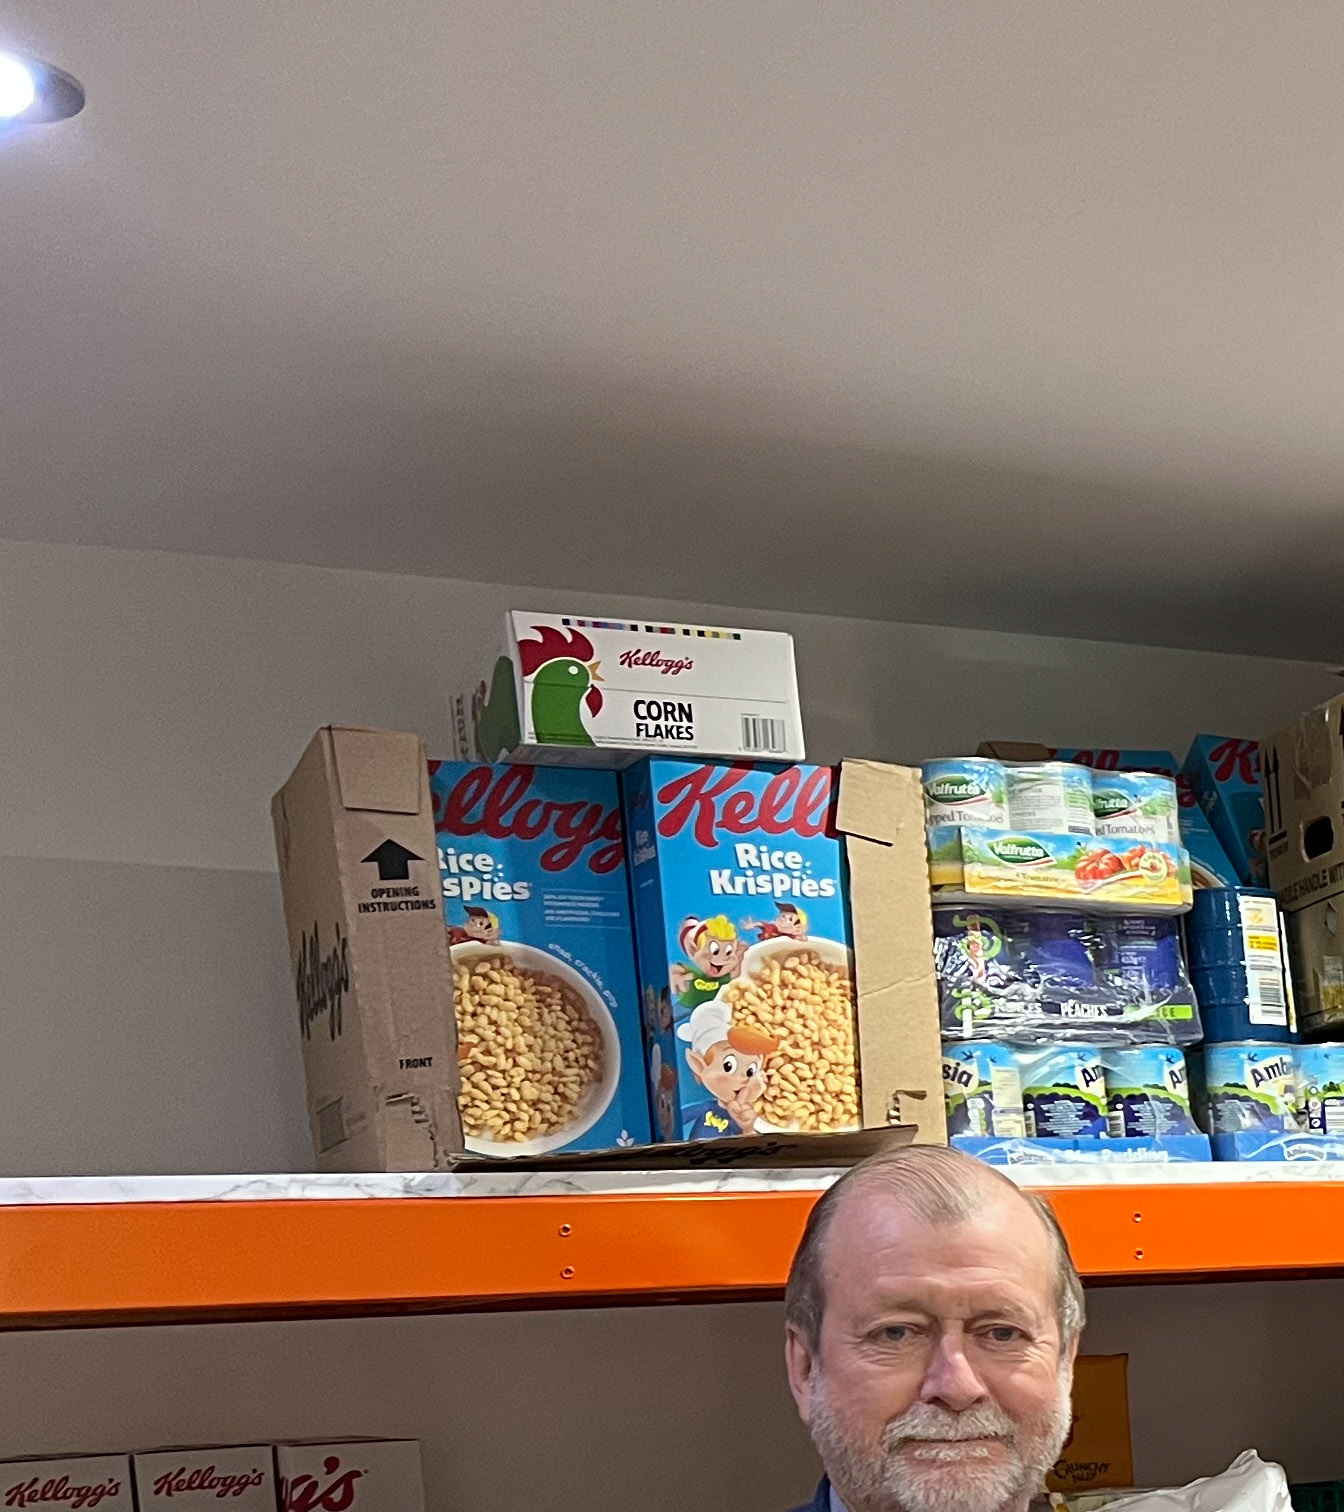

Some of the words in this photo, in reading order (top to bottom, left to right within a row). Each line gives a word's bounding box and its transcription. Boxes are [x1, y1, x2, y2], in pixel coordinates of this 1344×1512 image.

[619, 648, 694, 676] Kellogg's
[633, 699, 693, 724] CORN
[635, 721, 694, 741] FLAKES
[735, 842, 803, 870] Rice
[993, 842, 1045, 858] Valfrutta
[371, 886, 419, 899] OPENING
[710, 869, 835, 898] Krispies
[358, 900, 436, 914] INSTRUCTIONS
[1061, 1000, 1108, 1017] PEACHES
[1053, 1459, 1111, 1477] CRUNCHY
[5, 1476, 122, 1509] Kellogg's
[154, 1465, 265, 1498] Kellogg's
